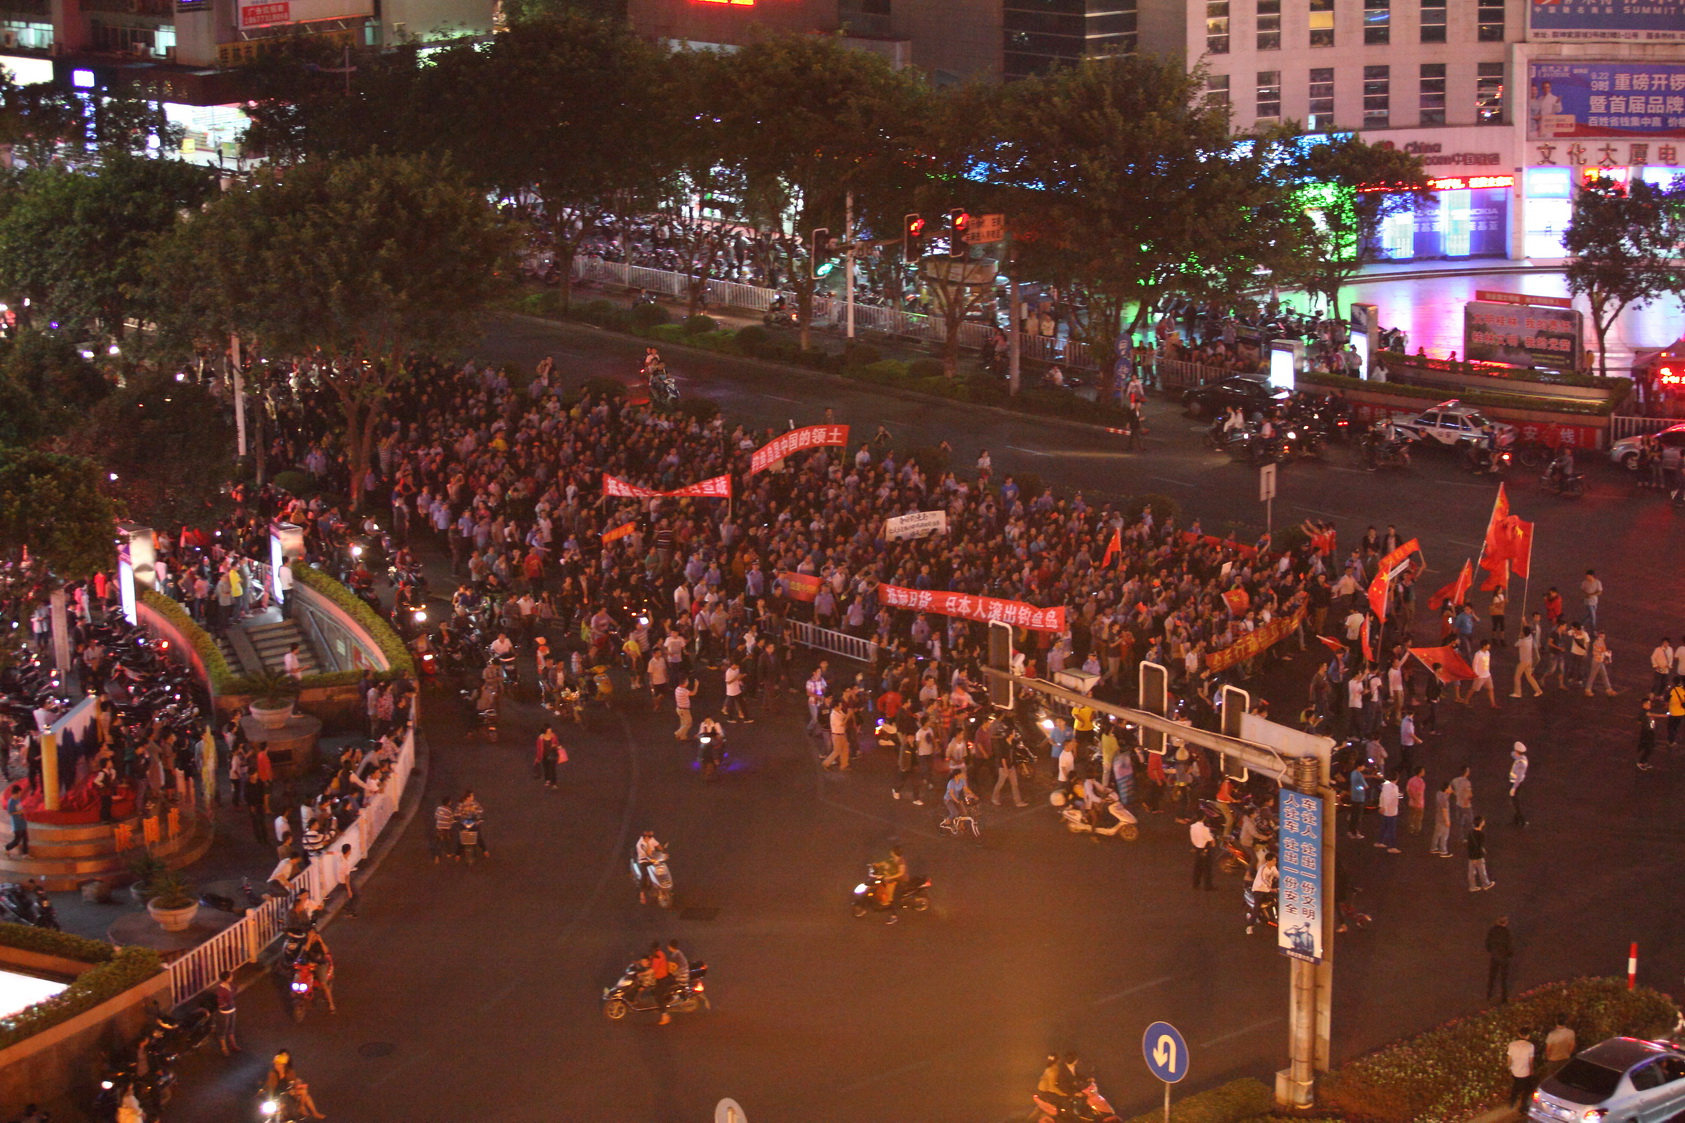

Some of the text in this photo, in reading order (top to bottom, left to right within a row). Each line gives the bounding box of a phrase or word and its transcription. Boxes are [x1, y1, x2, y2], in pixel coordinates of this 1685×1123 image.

[1623, 6, 1676, 14] SUMMIT
[1589, 95, 1685, 114] 暨首届品牌
[1405, 141, 1442, 153] China
[1537, 143, 1678, 166] 文化大厦电
[751, 428, 842, 472] 钓鱼岛是中国的领土
[1283, 837, 1299, 915] 让出一份安全
[1300, 842, 1317, 920] 让出一份文明
